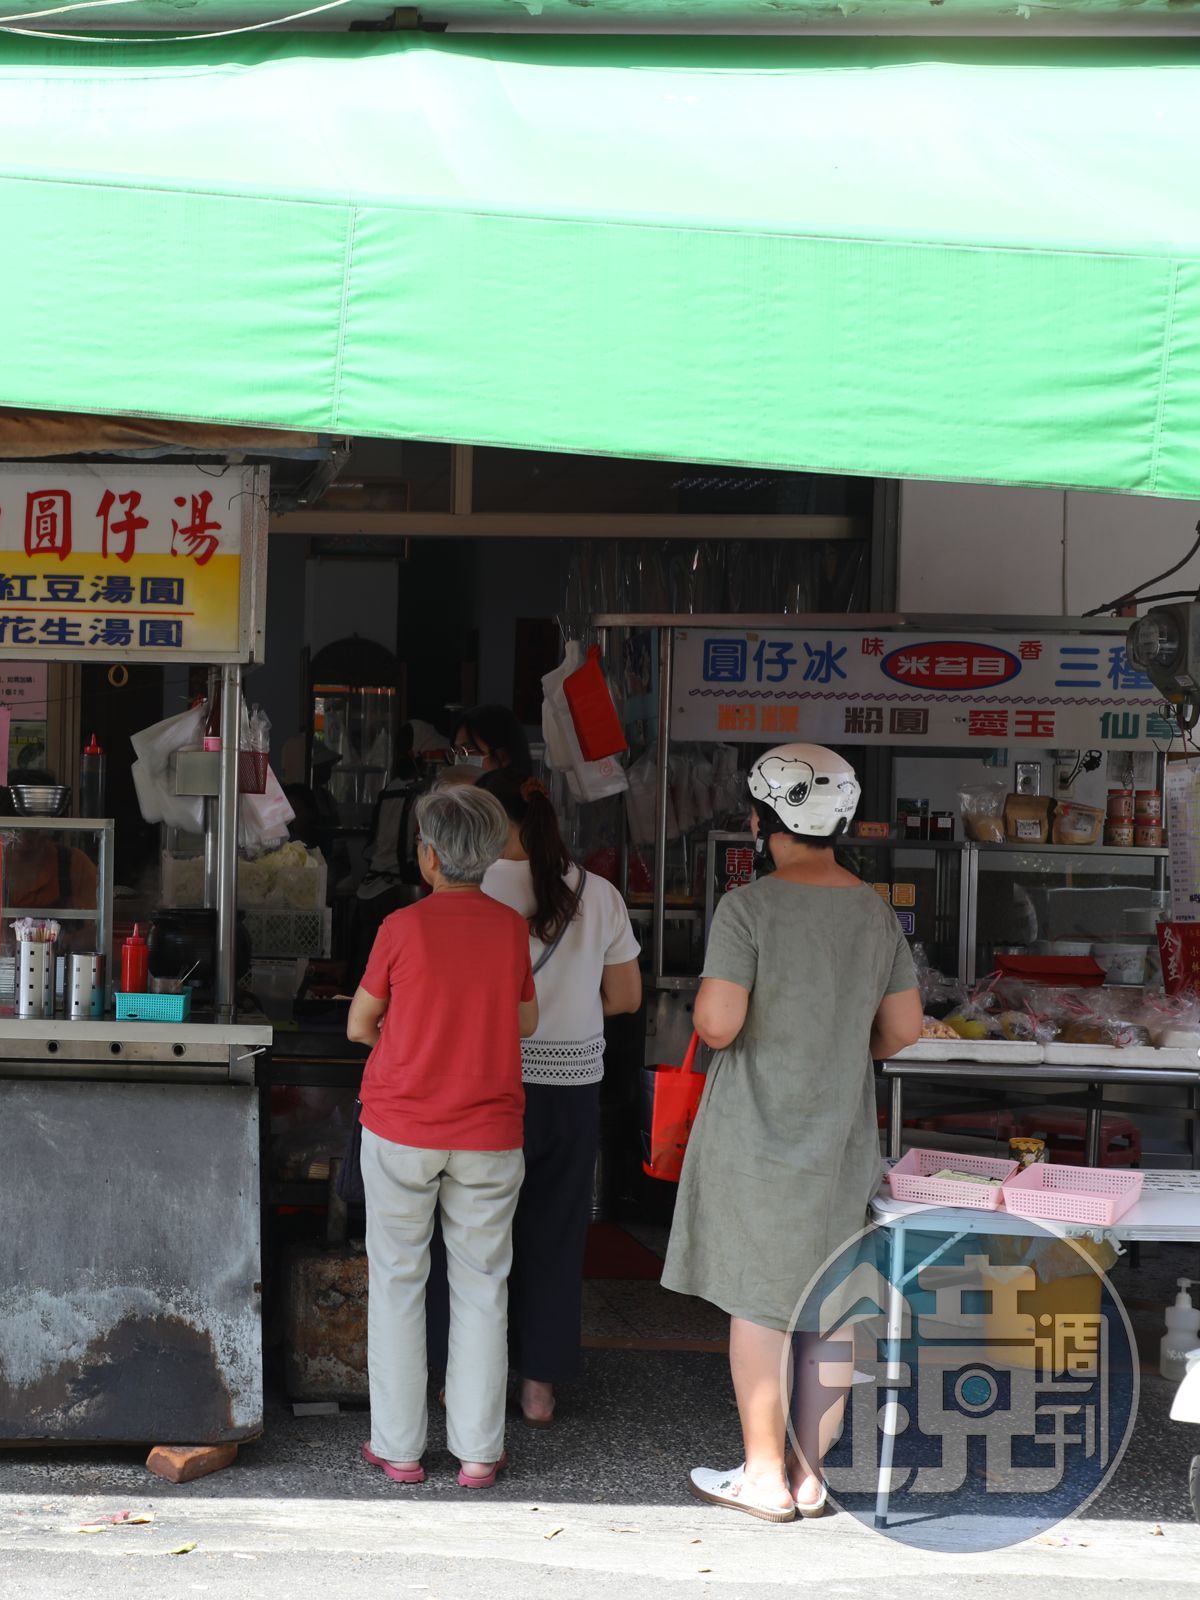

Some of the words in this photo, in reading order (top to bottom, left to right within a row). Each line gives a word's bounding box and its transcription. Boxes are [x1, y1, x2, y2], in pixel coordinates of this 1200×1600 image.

[703, 638, 848, 684] 圓仔冰
[896, 655, 1007, 677] 米苔目
[844, 706, 929, 735] 粉圓
[968, 710, 1056, 738] 愛玉
